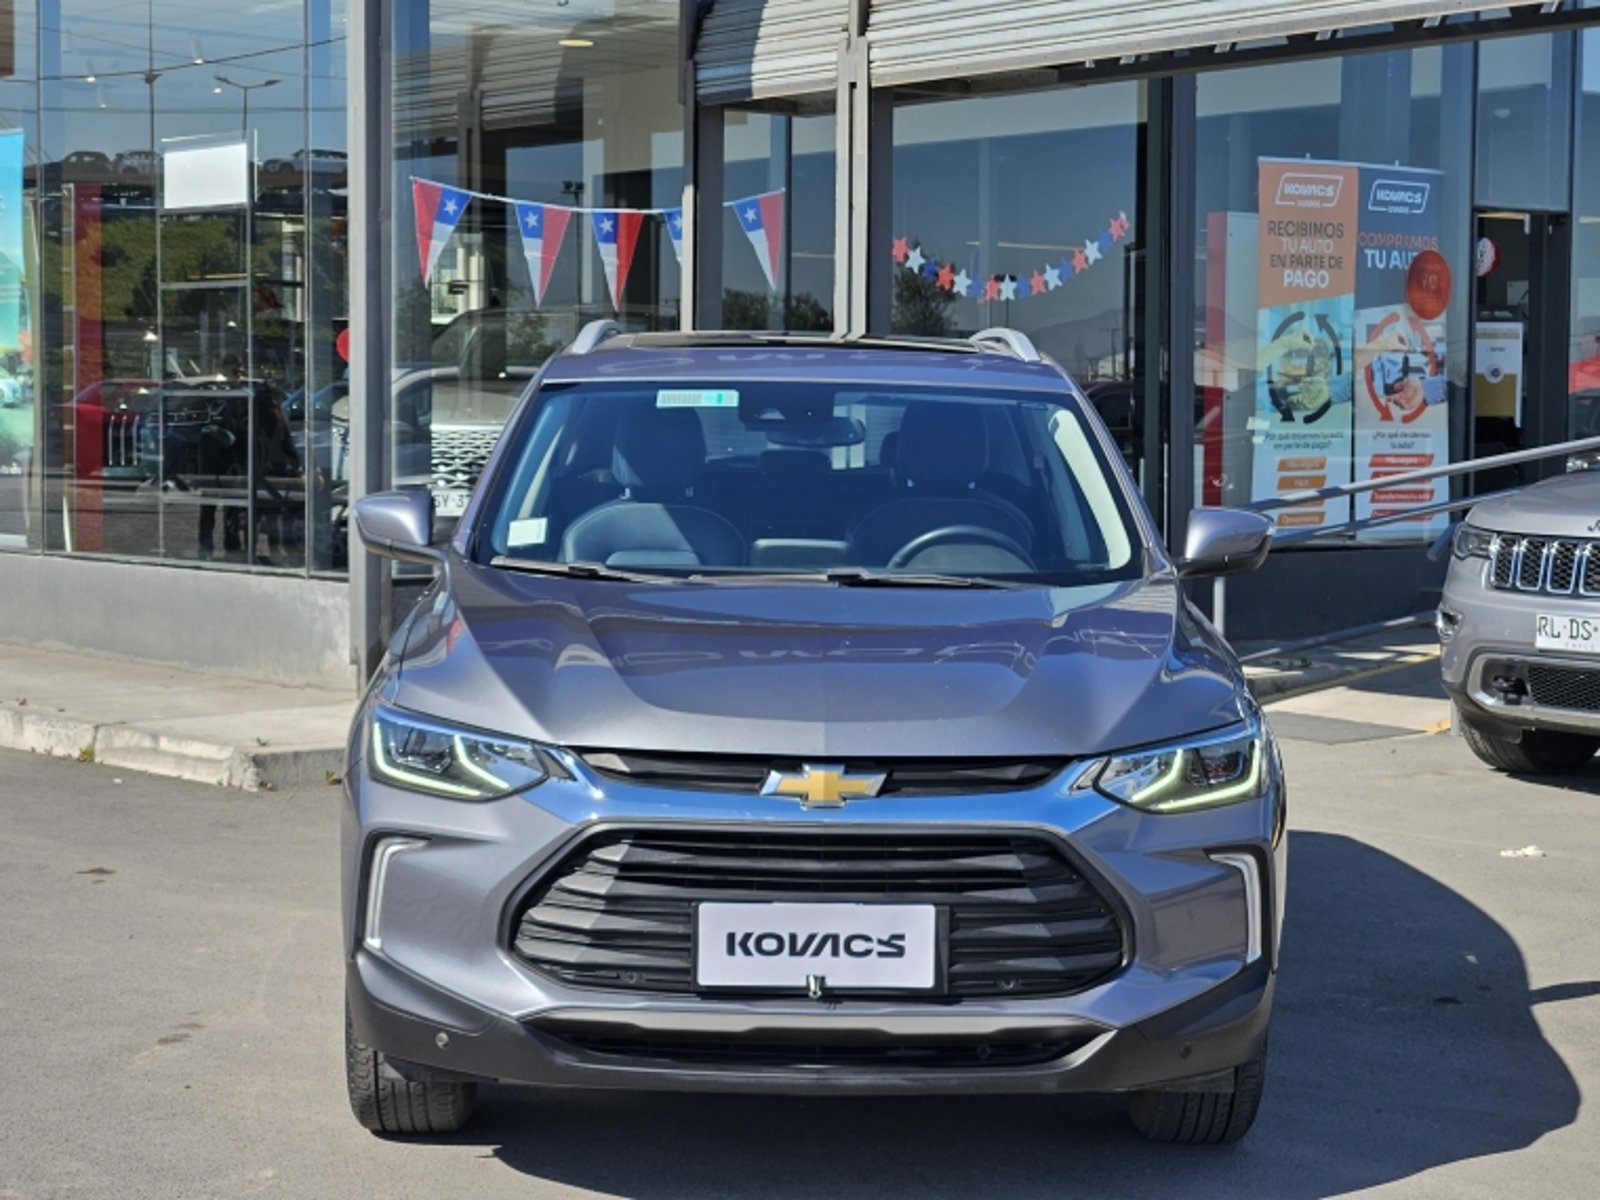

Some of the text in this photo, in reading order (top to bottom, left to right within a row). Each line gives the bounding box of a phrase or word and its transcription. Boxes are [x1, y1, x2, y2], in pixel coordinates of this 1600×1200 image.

[1267, 220, 1344, 238] RECIBIMOS
[1281, 237, 1333, 253] TU AUTO
[1359, 232, 1439, 249] COMPRAMOS
[1270, 254, 1344, 269] EN PARTE DE
[1364, 248, 1386, 269] TU
[1283, 269, 1330, 288] PAGO
[726, 932, 905, 958] KOVACS
